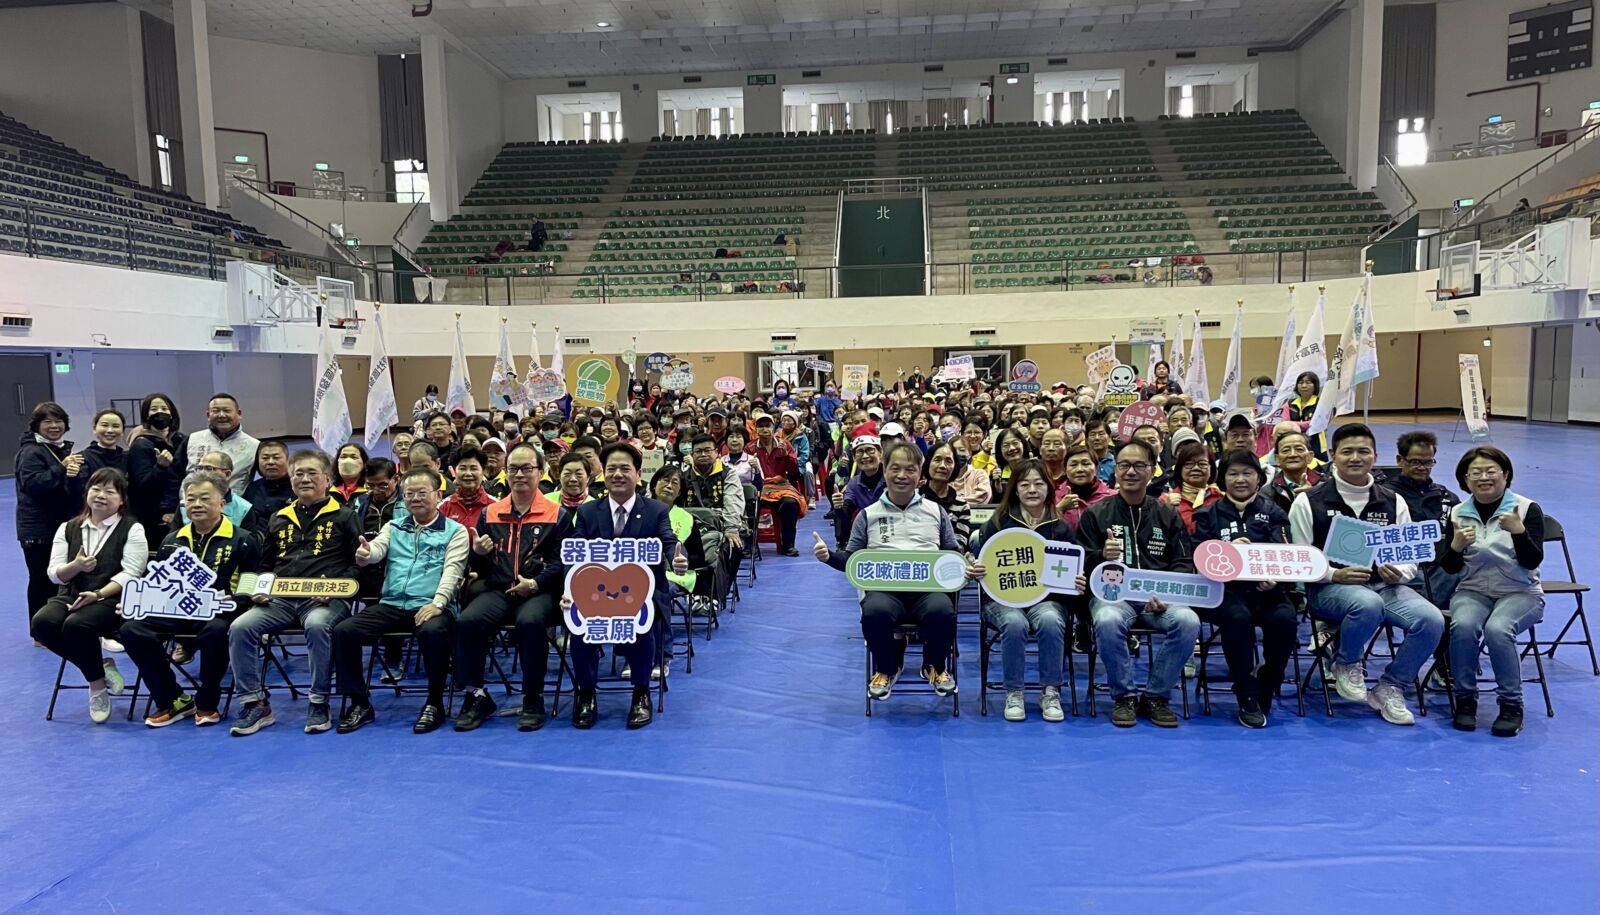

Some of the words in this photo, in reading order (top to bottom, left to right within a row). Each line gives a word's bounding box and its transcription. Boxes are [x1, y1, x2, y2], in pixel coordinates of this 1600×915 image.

[877, 205, 890, 219] 北
[1011, 382, 1039, 390] 安全性行為
[1365, 523, 1438, 547] 正確使用
[563, 540, 660, 563] 器官捐贈
[995, 546, 1035, 567] 定期
[1248, 549, 1311, 562] 兒童發展
[1376, 543, 1432, 564] 保險套
[169, 551, 213, 591] 接種
[857, 561, 930, 580] 咳嗽禮節
[998, 569, 1038, 590] 篩檢
[1249, 563, 1313, 576] 篩檢6+7
[149, 564, 203, 616] 卡介苗
[276, 581, 350, 593] 預立醫療決定
[1129, 578, 1209, 598] 安寧緩和療護
[585, 618, 635, 641] 意願
